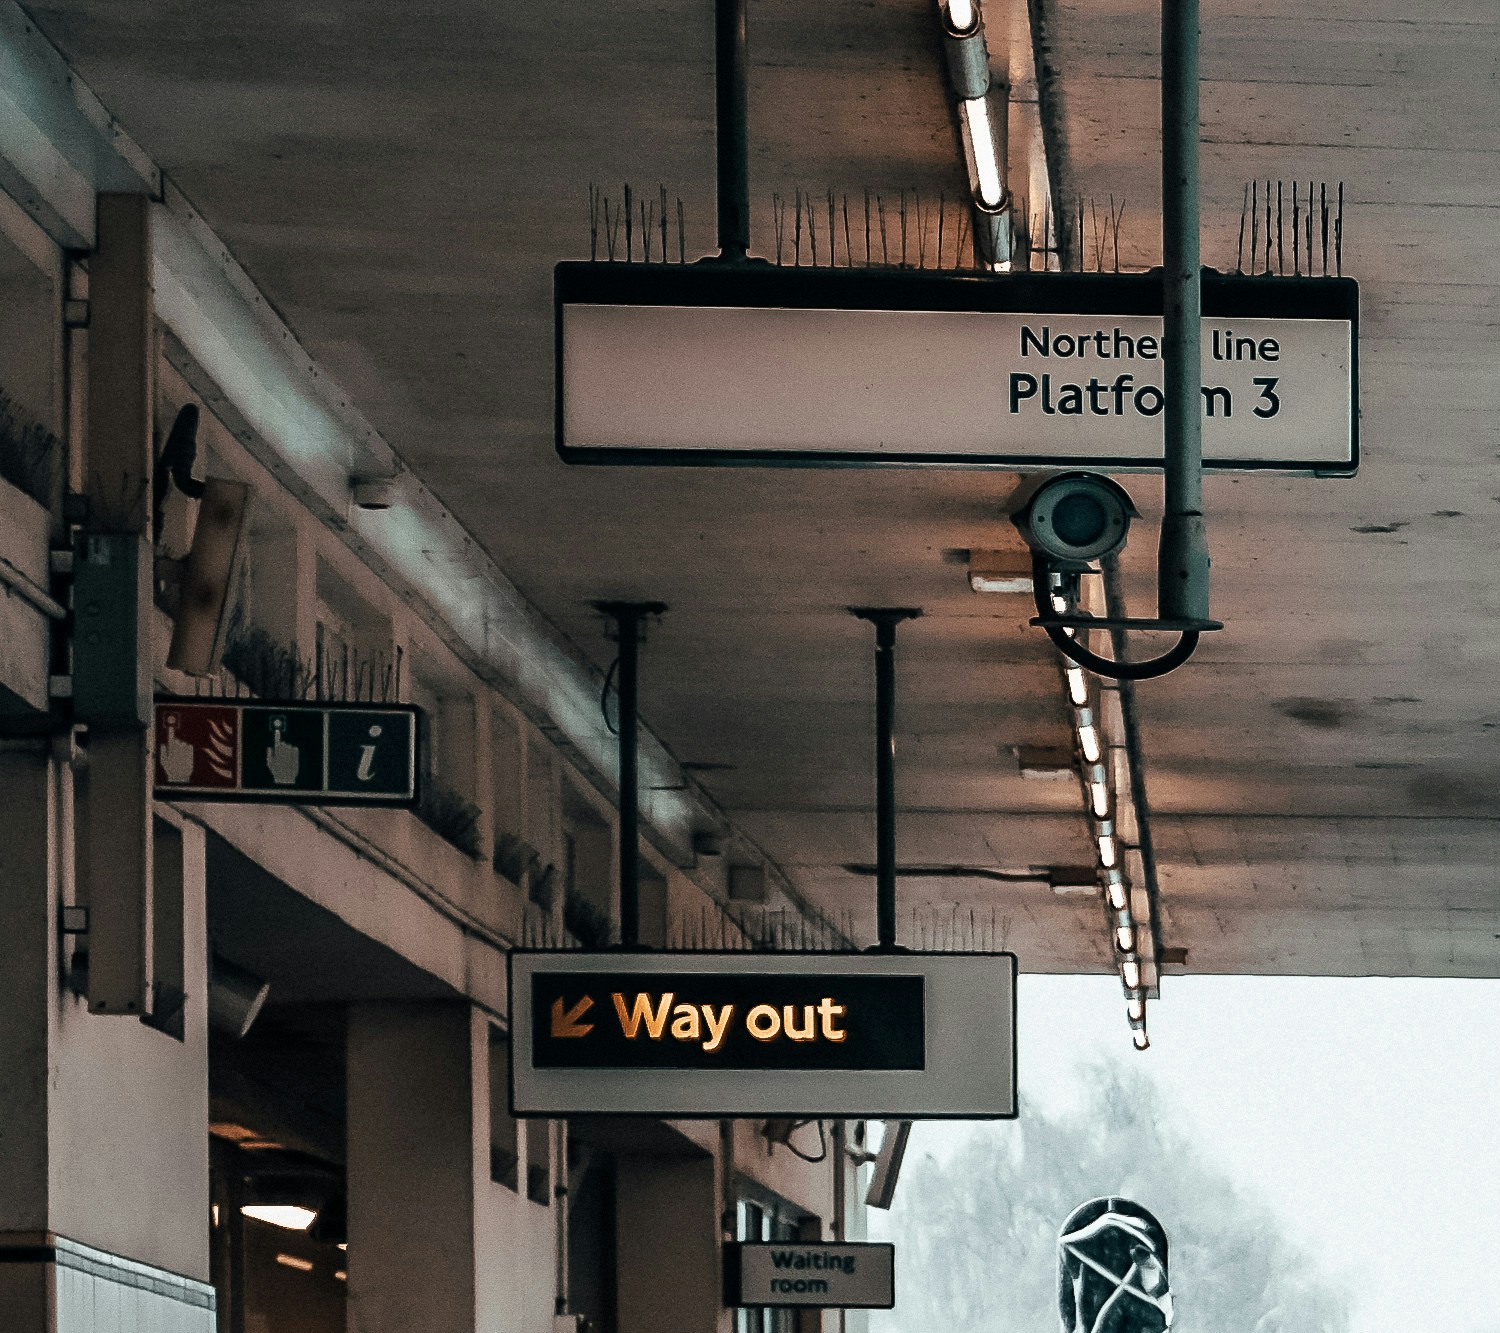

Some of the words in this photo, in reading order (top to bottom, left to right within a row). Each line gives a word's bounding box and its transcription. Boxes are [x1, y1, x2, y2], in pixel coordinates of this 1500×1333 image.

[1020, 325, 1165, 359] Northe
[1212, 329, 1280, 362] line
[1009, 372, 1232, 417] Platfom
[1252, 377, 1280, 419] 3
[611, 992, 734, 1052] Way
[746, 997, 846, 1041] out
[770, 1250, 856, 1275] Waiting
[770, 1278, 828, 1293] room
